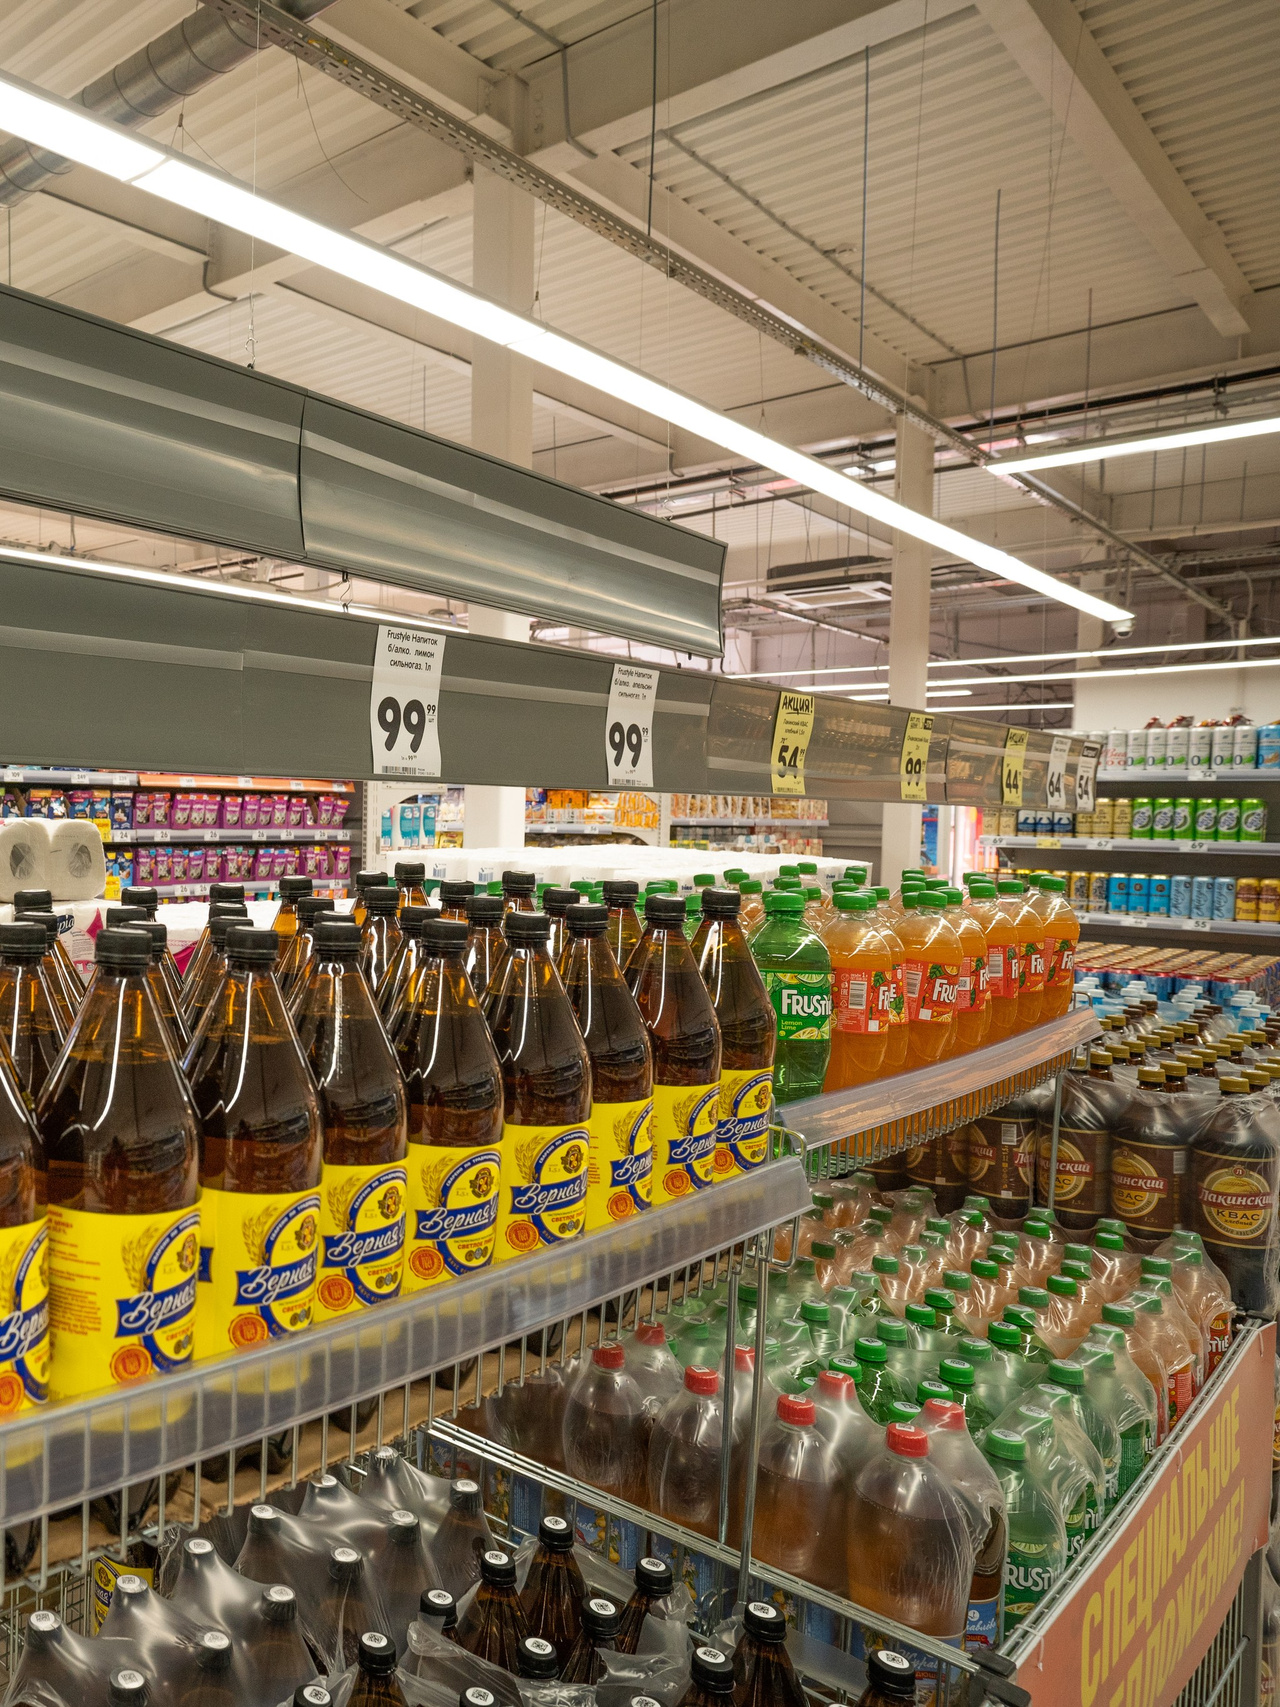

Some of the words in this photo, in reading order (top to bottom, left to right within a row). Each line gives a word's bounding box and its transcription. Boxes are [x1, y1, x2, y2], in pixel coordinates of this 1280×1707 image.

[387, 630, 410, 642] Frustyle
[412, 634, 438, 645] Напиток
[388, 644, 411, 655] б/алко.
[414, 649, 434, 658] лимон
[390, 659, 422, 670] сильногаз.
[425, 662, 431, 671] 1л
[618, 667, 633, 678] Frustyle
[634, 669, 652, 679] Напиток
[632, 682, 652, 690] апельсин
[427, 704, 436, 714] 99
[782, 695, 814, 715] АКЦИЯ!
[378, 697, 425, 753] 99
[642, 727, 649, 736] 99
[609, 721, 642, 768] 99
[778, 745, 799, 779] 54
[905, 757, 921, 787] 99
[1005, 769, 1019, 795] 44
[1048, 771, 1062, 798] 64
[1078, 774, 1090, 800] 54
[161, 831, 168, 839] 26
[286, 829, 292, 837] 26
[539, 1143, 555, 1164] СВАРЕНО
[554, 1138, 562, 1147] ПО
[446, 1167, 464, 1188] СВАРЕНО
[464, 1161, 472, 1170] ПО
[514, 1183, 581, 1215] Верная
[1199, 1189, 1273, 1207] Лакински
[419, 1207, 490, 1241] Верная
[551, 1214, 574, 1223] СВЕТЛОЕ
[1217, 1209, 1260, 1221] КВАС
[1224, 1218, 1253, 1227] хлебный
[327, 1231, 399, 1268] Верная
[457, 1240, 481, 1250] СВЕТЛОЕ
[240, 1262, 313, 1305] Верная
[1081, 1384, 1240, 1707] СПЕЦИАЛЬНОЕ
